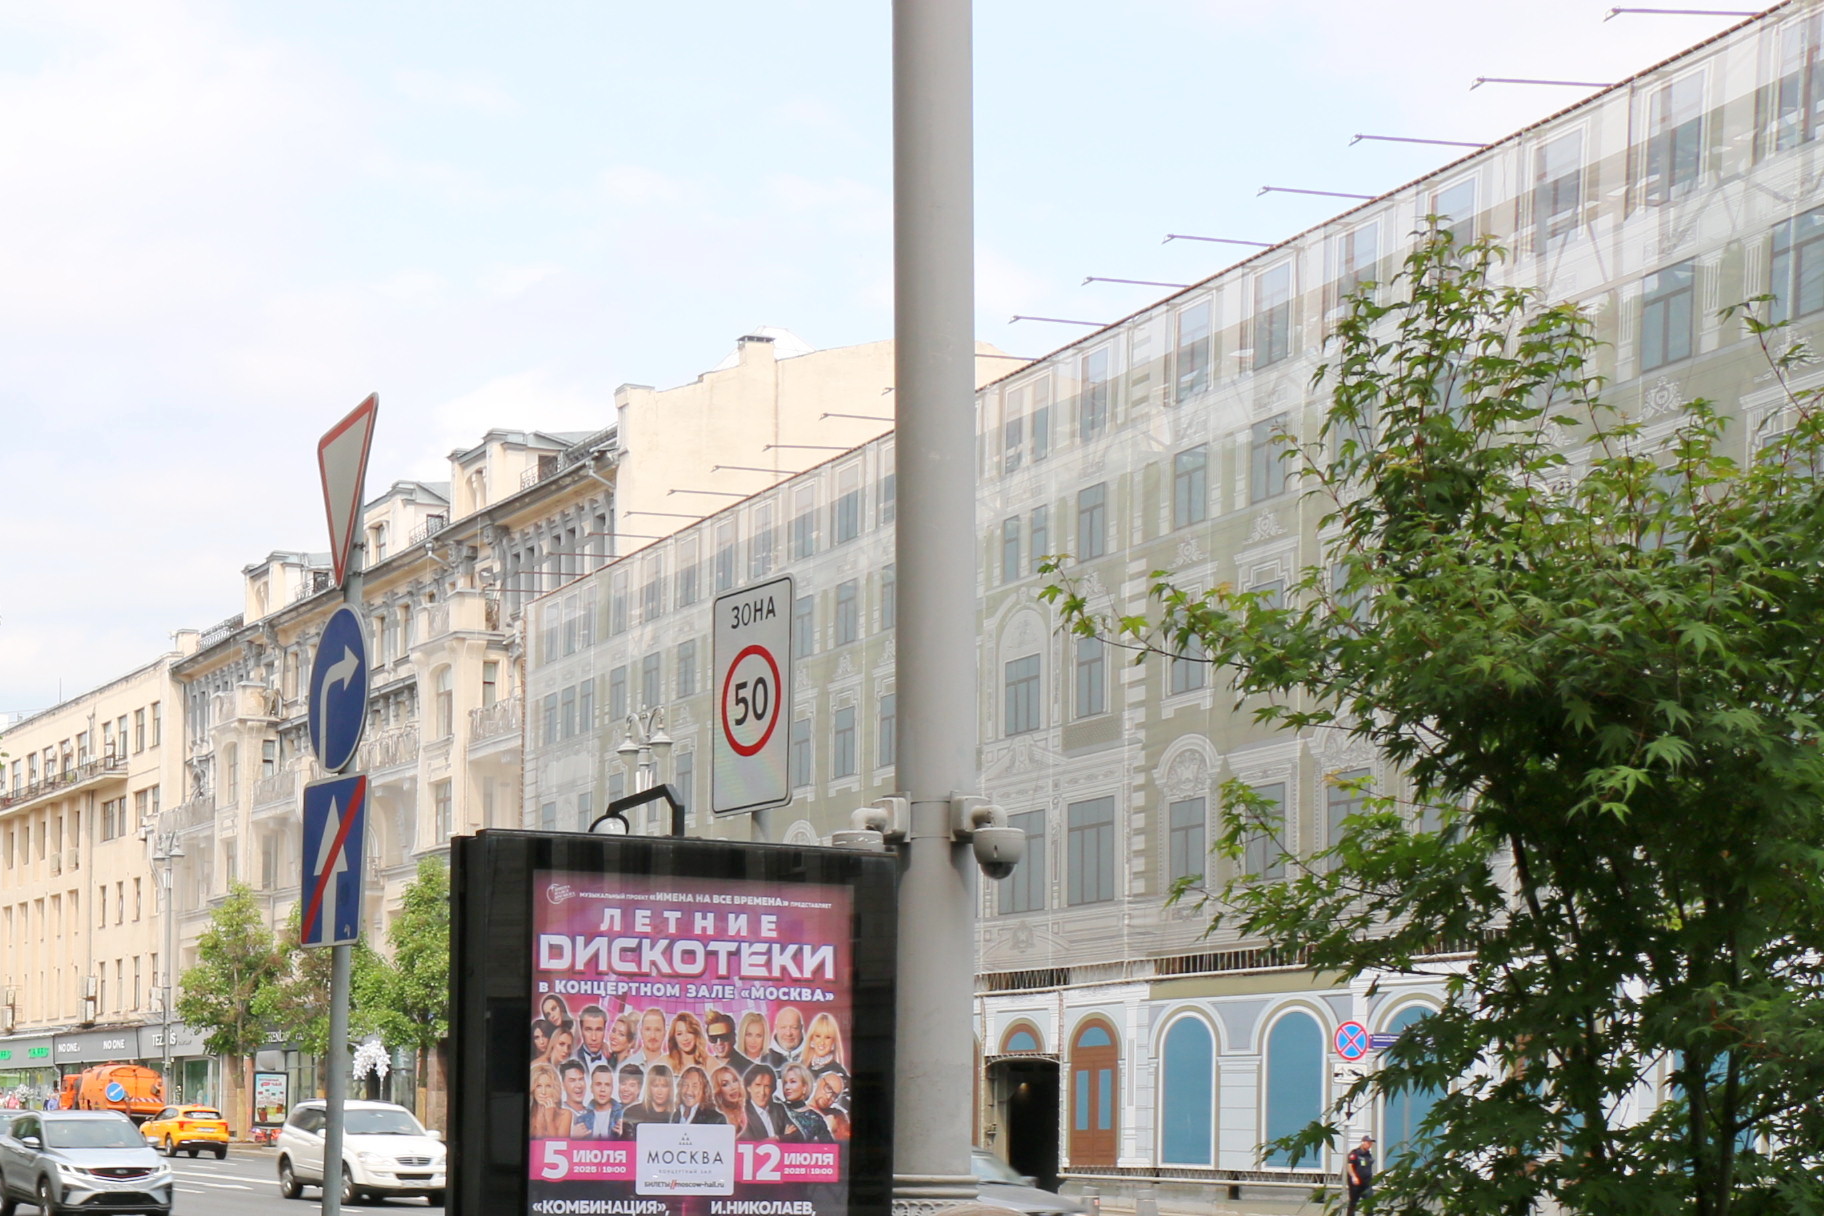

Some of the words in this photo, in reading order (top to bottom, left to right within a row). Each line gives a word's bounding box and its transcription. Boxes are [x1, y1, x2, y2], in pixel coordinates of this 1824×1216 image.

[731, 596, 776, 629] ЗОНА
[735, 676, 768, 726] 50
[579, 891, 625, 900] МУЗЫКАЛЬНЫЙ
[649, 891, 694, 903] «ИМЕНА
[696, 893, 709, 904] НА
[713, 894, 732, 905] ВСЕ
[734, 895, 789, 907] ВРЕМЕНА»
[600, 907, 778, 938] ЛЕТНИЕ
[555, 980, 680, 997] КОНЦЕРТНОМ
[686, 983, 734, 999] ЗАЛЕ
[740, 986, 834, 1001] «МОСКВА»
[58, 1043, 67, 1053] NO
[103, 1040, 112, 1050] NO
[112, 1039, 125, 1049] ONE
[541, 1141, 569, 1179] 5
[572, 1149, 627, 1163] ИЮЛЯ
[646, 1150, 724, 1164] МОСКВА
[737, 1143, 781, 1180] 12
[783, 1153, 834, 1165] ИЮЛЯ
[532, 1200, 670, 1216] «КОМБИНАЦИЯ»,
[710, 1200, 816, 1216] И.НИКОЛАЕВ,
